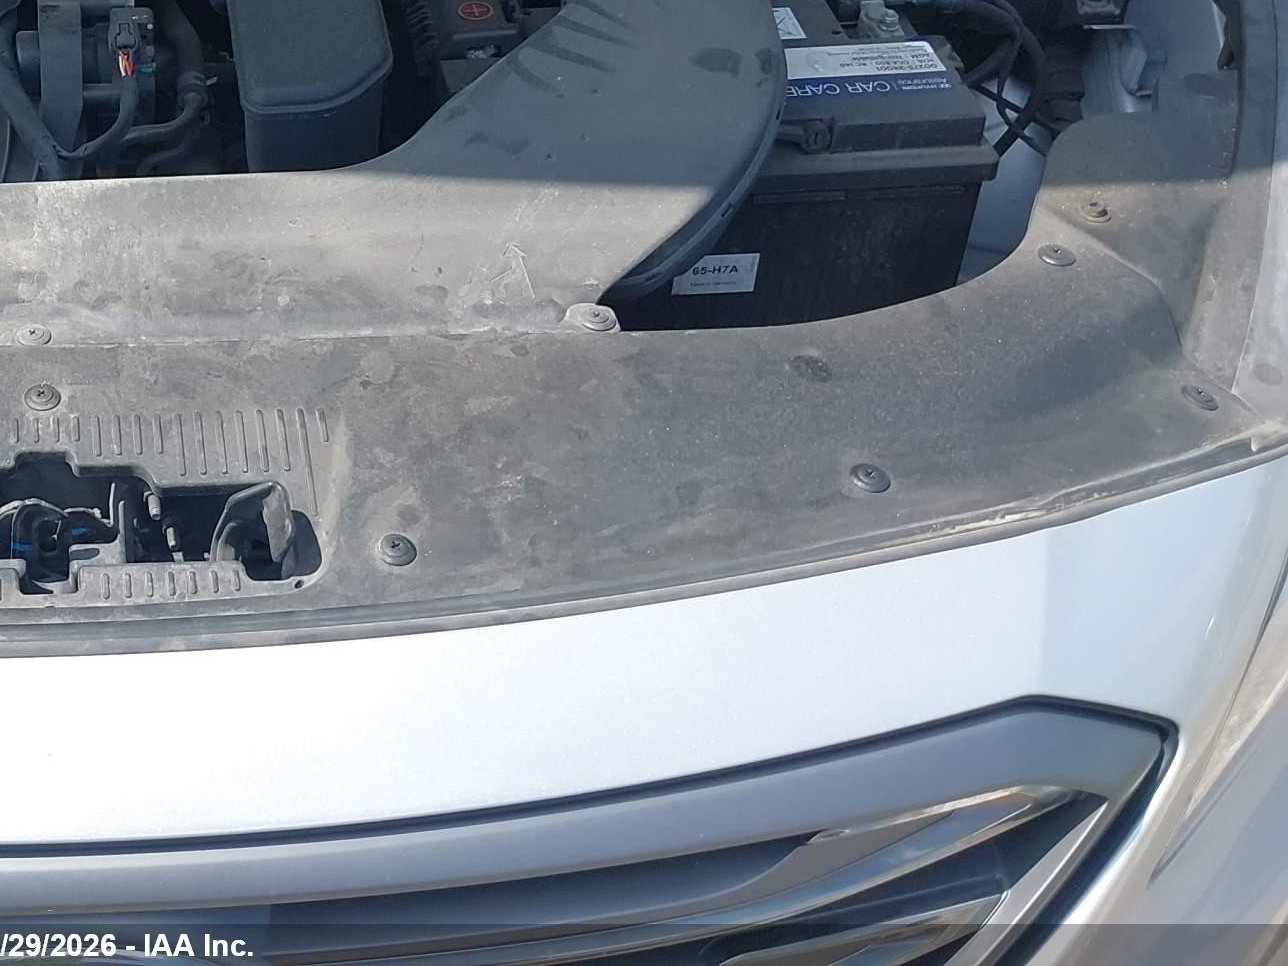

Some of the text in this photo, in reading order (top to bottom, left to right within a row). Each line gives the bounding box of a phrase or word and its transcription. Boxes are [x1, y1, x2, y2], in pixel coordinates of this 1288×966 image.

[786, 80, 891, 97] CAR CARE
[692, 265, 739, 275] 65-H7A
